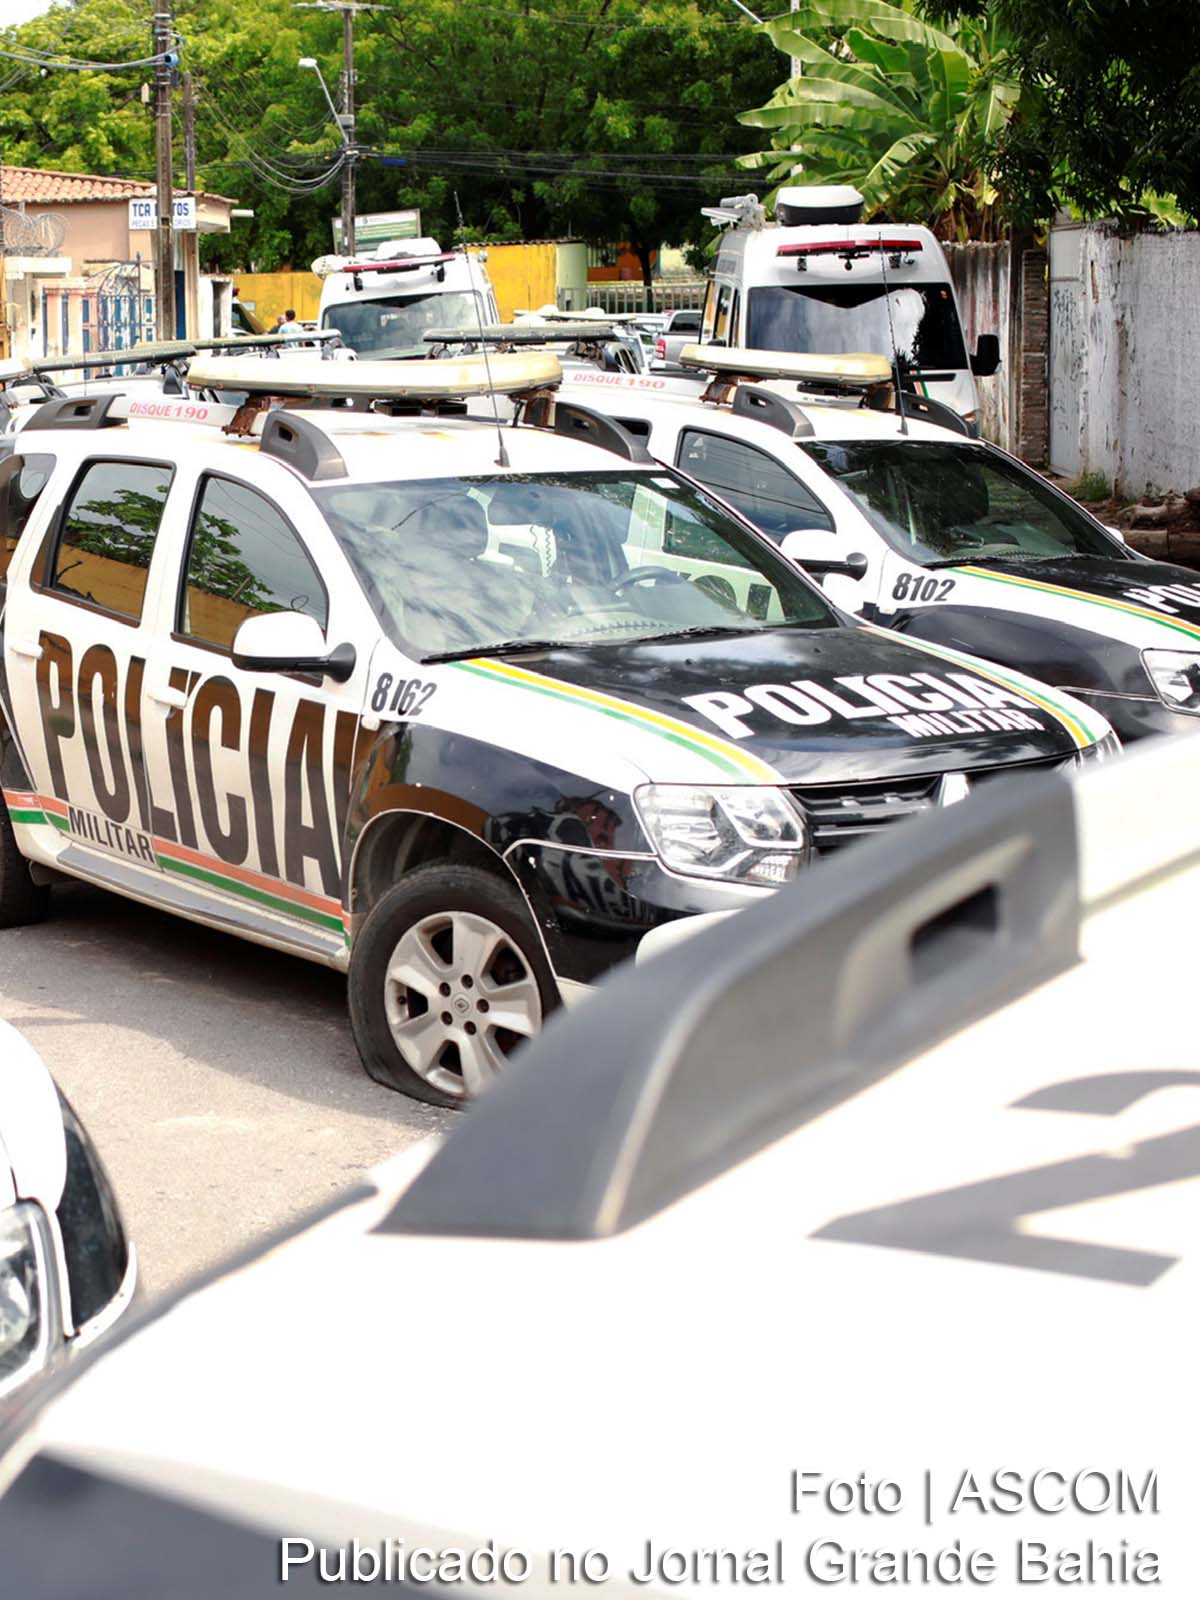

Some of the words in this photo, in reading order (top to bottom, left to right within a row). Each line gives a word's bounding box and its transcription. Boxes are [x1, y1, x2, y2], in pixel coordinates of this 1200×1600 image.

[627, 378, 666, 389] 190
[129, 403, 172, 417] DISQUE
[176, 406, 208, 420] 190
[891, 573, 956, 602] 8102
[371, 672, 438, 716] 8162
[885, 709, 1046, 738] MILITAR
[68, 806, 156, 864] MILITAR
